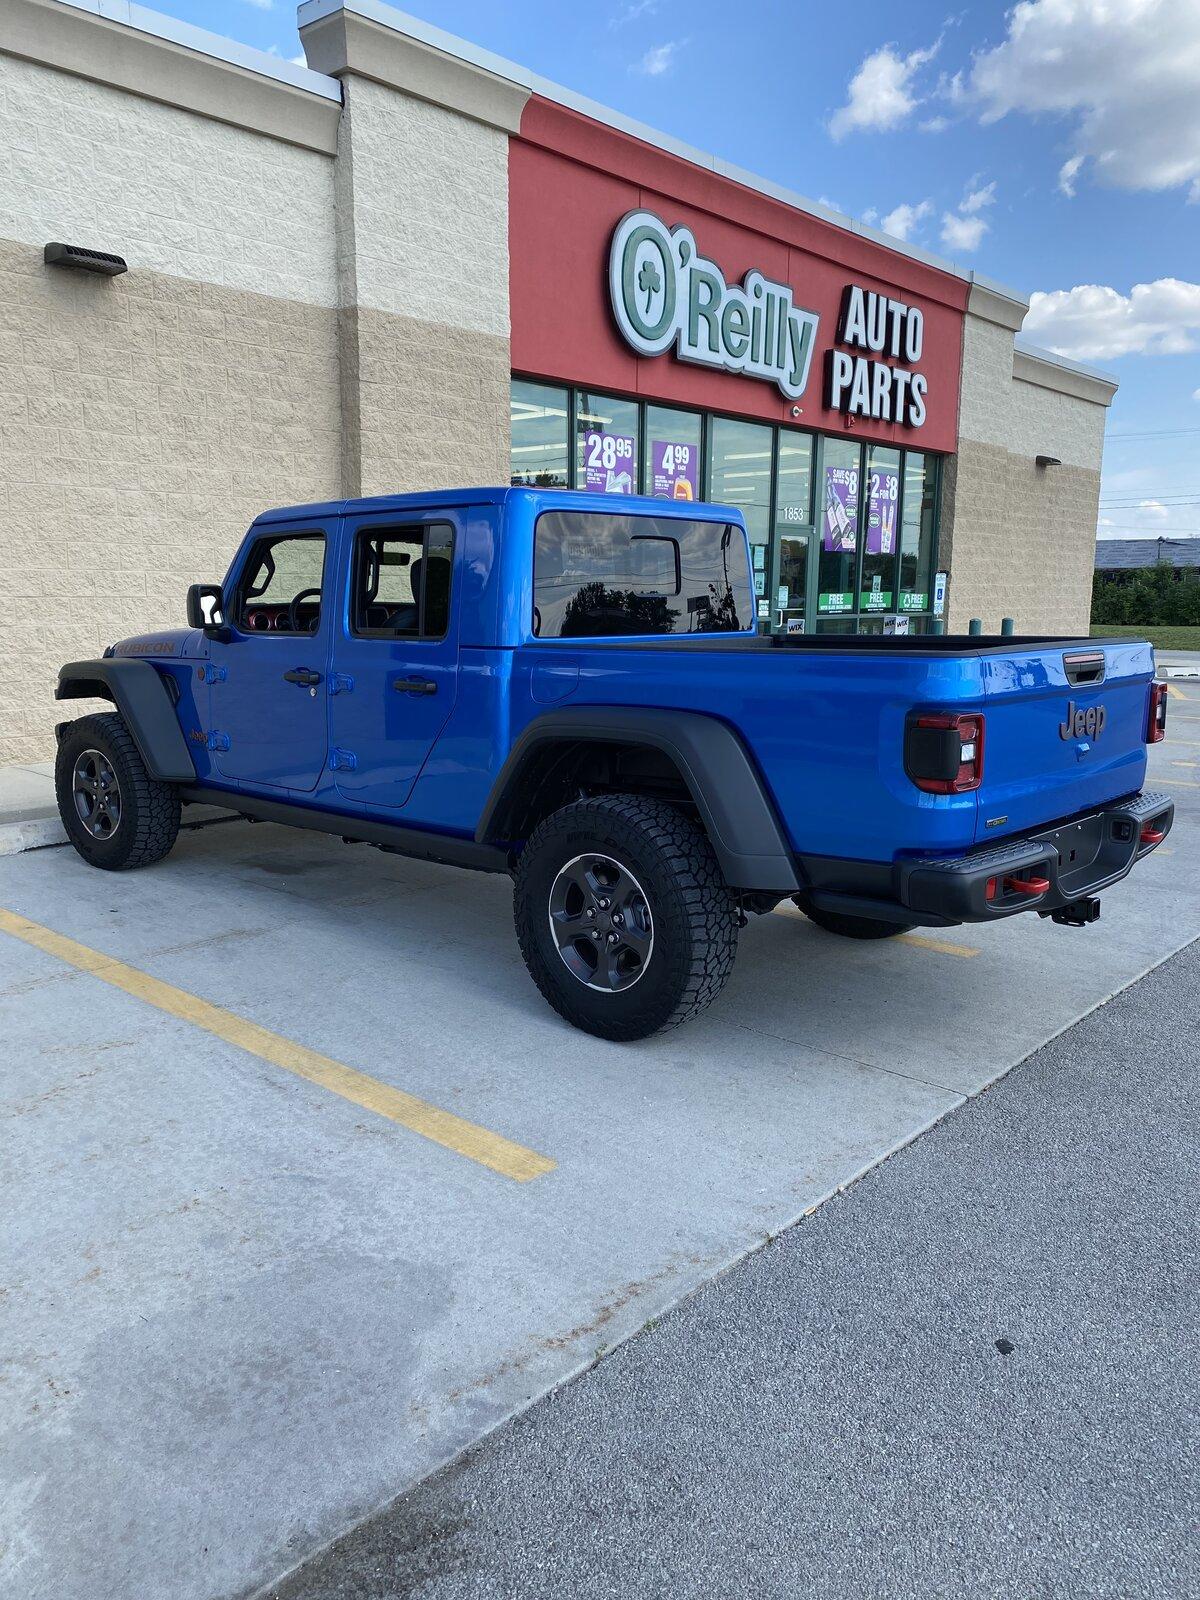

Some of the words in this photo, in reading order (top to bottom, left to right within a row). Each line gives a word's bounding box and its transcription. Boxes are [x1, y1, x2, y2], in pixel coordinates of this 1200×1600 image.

[621, 224, 813, 387] O'Reilly
[843, 285, 924, 363] AUTO
[831, 349, 928, 429] PARTS
[870, 474, 880, 499] 2
[879, 489, 889, 500] FOR
[783, 508, 804, 521] 1853
[828, 593, 844, 605] FREE
[869, 592, 884, 603] FREE
[910, 593, 924, 604] FREE
[788, 623, 803, 633] WIX
[896, 619, 908, 628] WIX
[117, 641, 176, 654] RUBICON
[1059, 700, 1107, 742] Jeep
